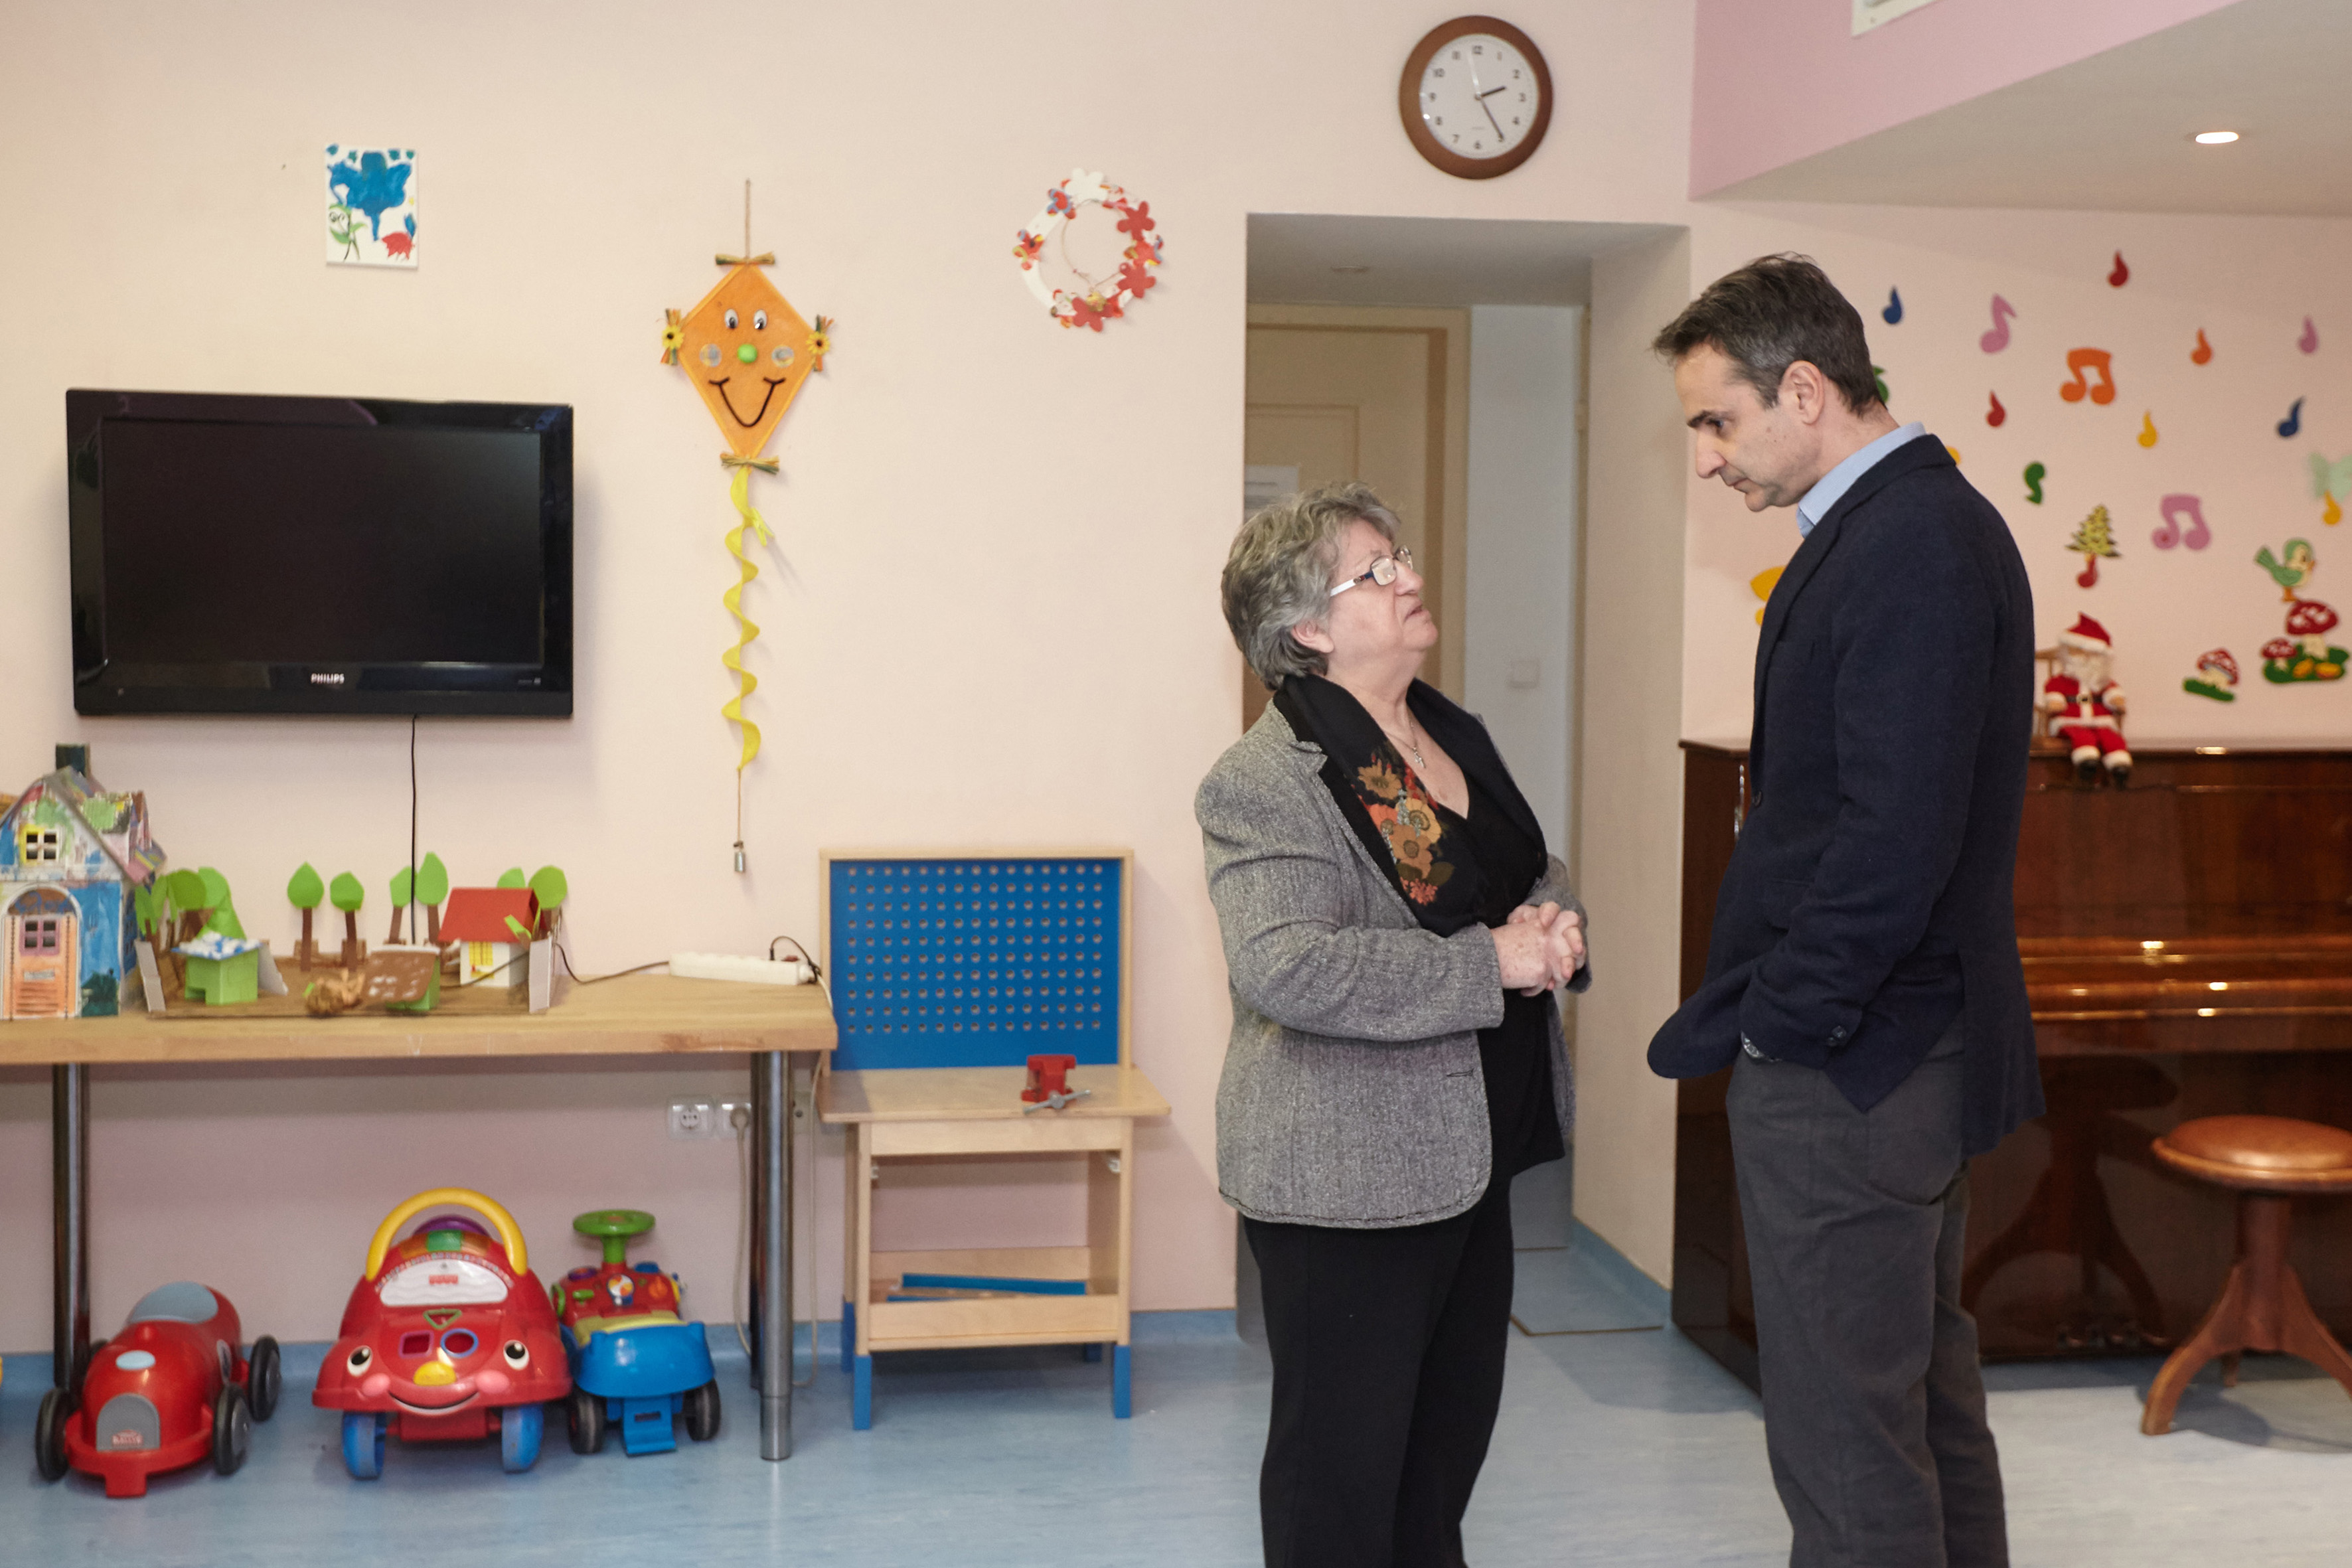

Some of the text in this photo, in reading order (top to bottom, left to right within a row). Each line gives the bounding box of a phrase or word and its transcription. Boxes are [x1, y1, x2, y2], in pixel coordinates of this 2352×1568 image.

[1512, 69, 1520, 79] 2
[1512, 116, 1520, 125] 4
[311, 673, 345, 684] PHILIPS
